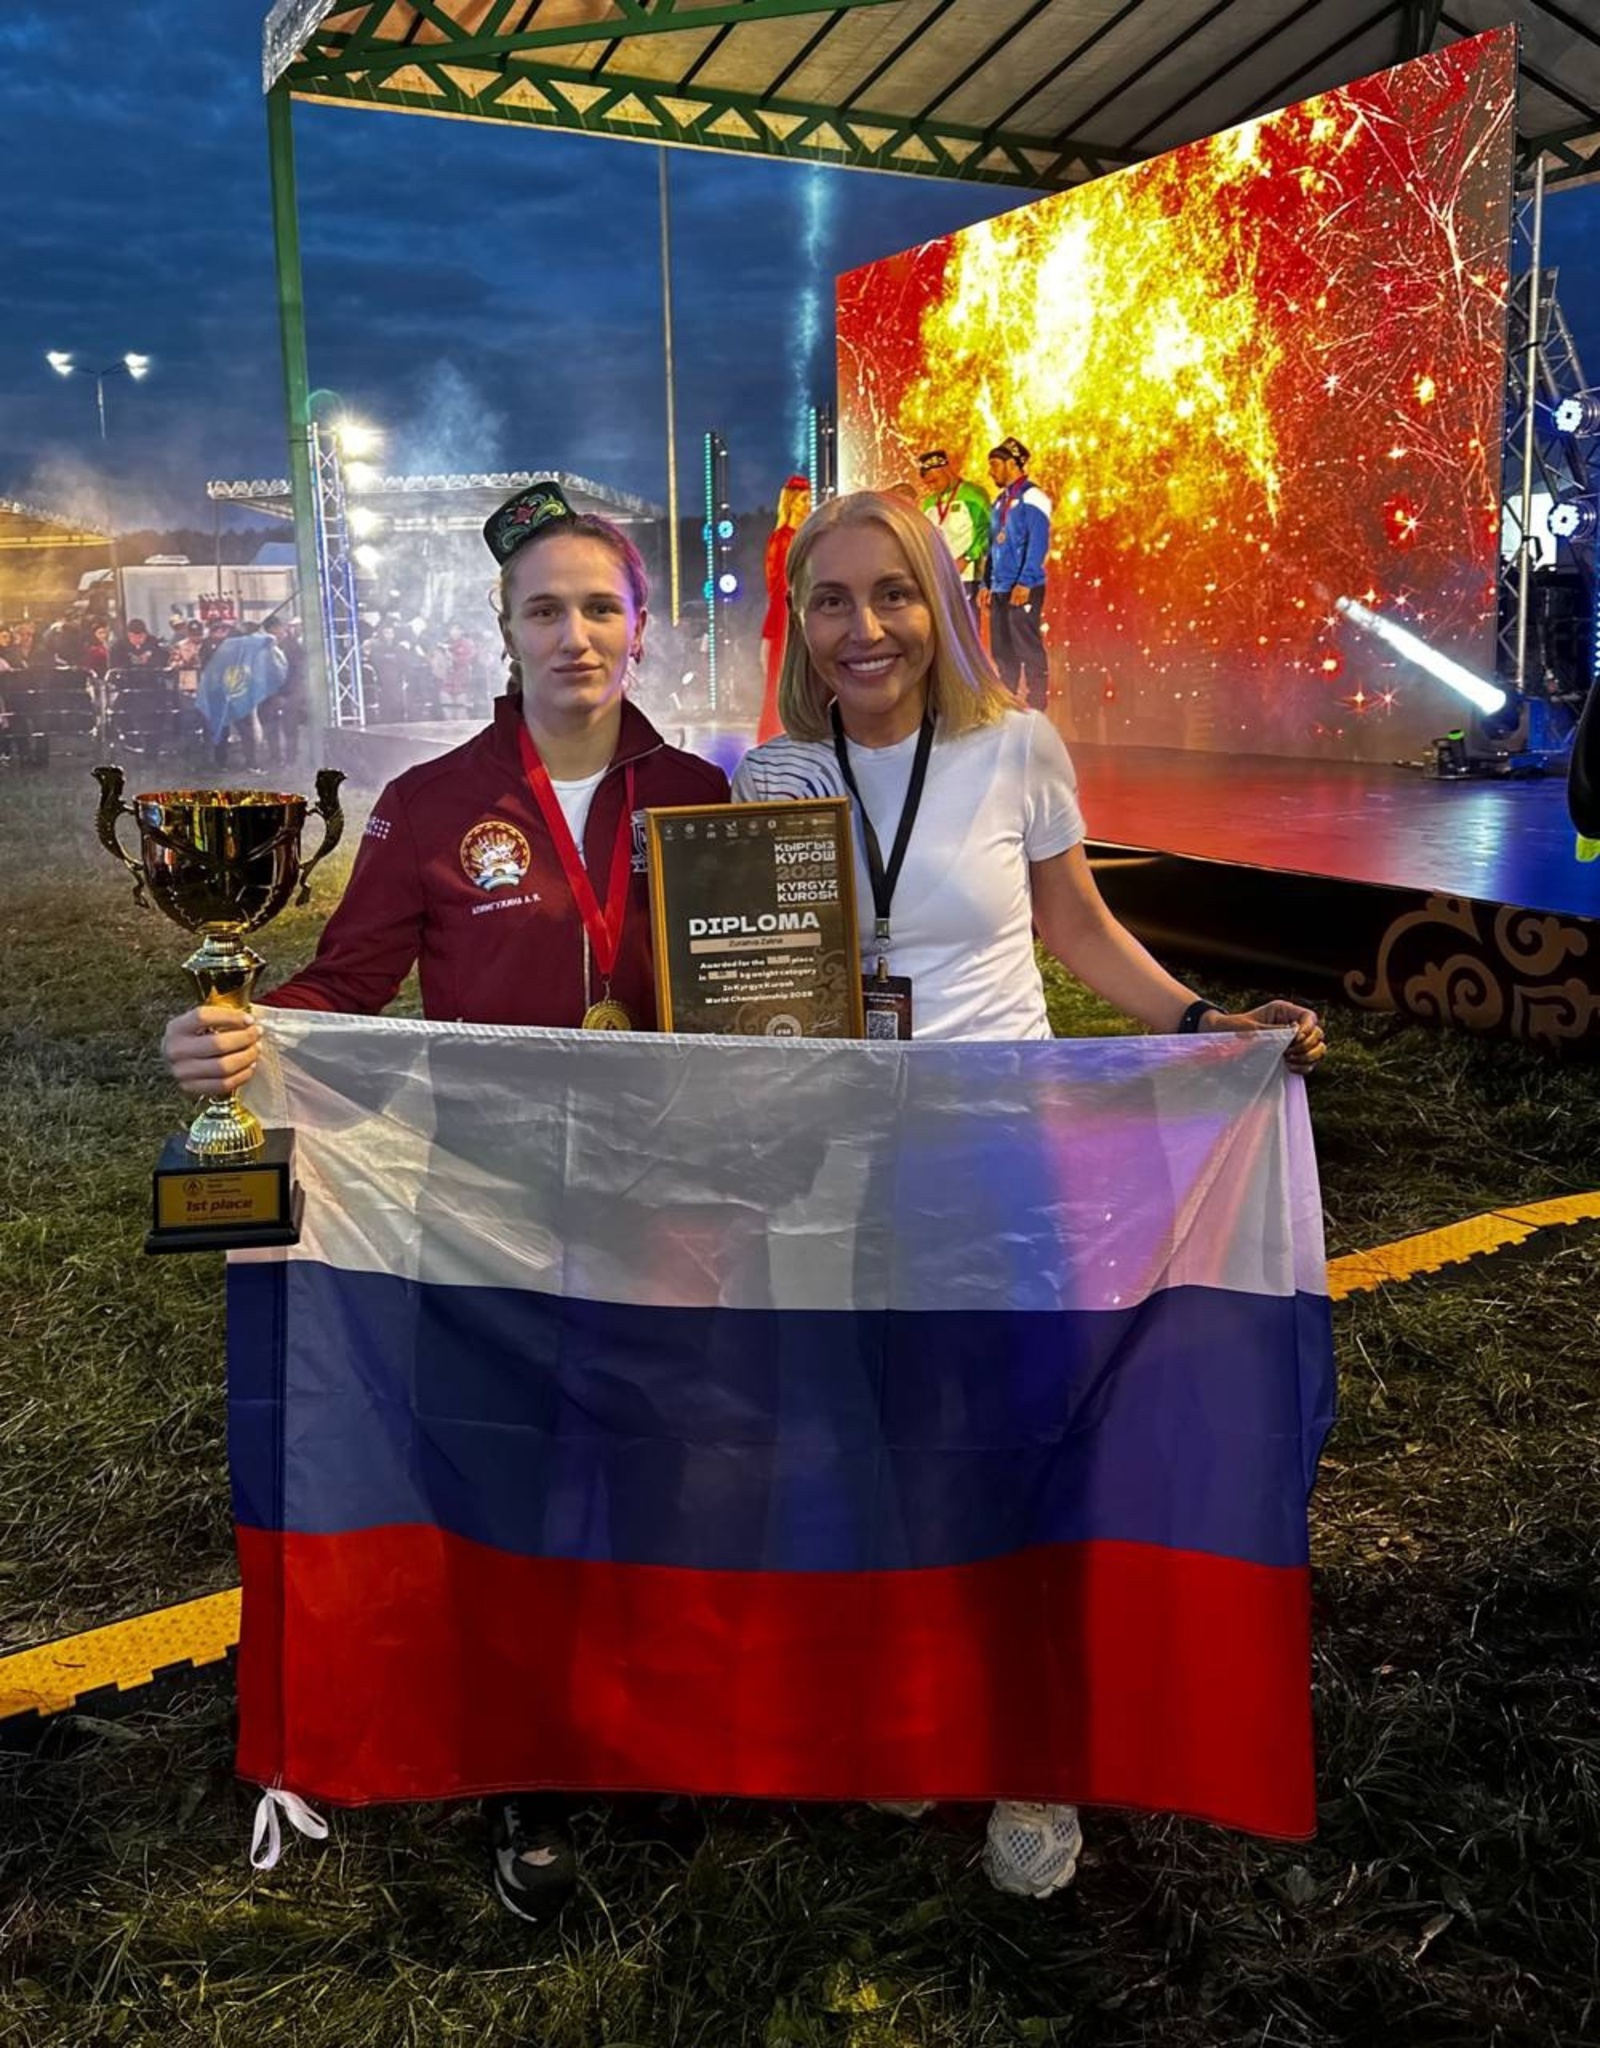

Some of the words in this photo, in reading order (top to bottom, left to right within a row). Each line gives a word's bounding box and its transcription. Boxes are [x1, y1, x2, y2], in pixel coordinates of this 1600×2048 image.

[774, 840, 835, 853] КЫРГЫЗ
[775, 851, 836, 864] КУРОШ
[776, 864, 837, 880] 2025
[777, 880, 838, 892] KYRGYZ
[777, 890, 838, 902] KUROSH
[689, 911, 820, 936] DIPLOMA
[700, 960, 737, 969] Awarded
[738, 959, 750, 967] for
[751, 958, 766, 967] the
[791, 956, 814, 965] place
[740, 971, 750, 980] kg
[751, 970, 778, 979] weight
[780, 968, 817, 977] category
[764, 980, 795, 988] Kurosh
[730, 993, 788, 1002] Championship
[211, 1198, 254, 1214] place
